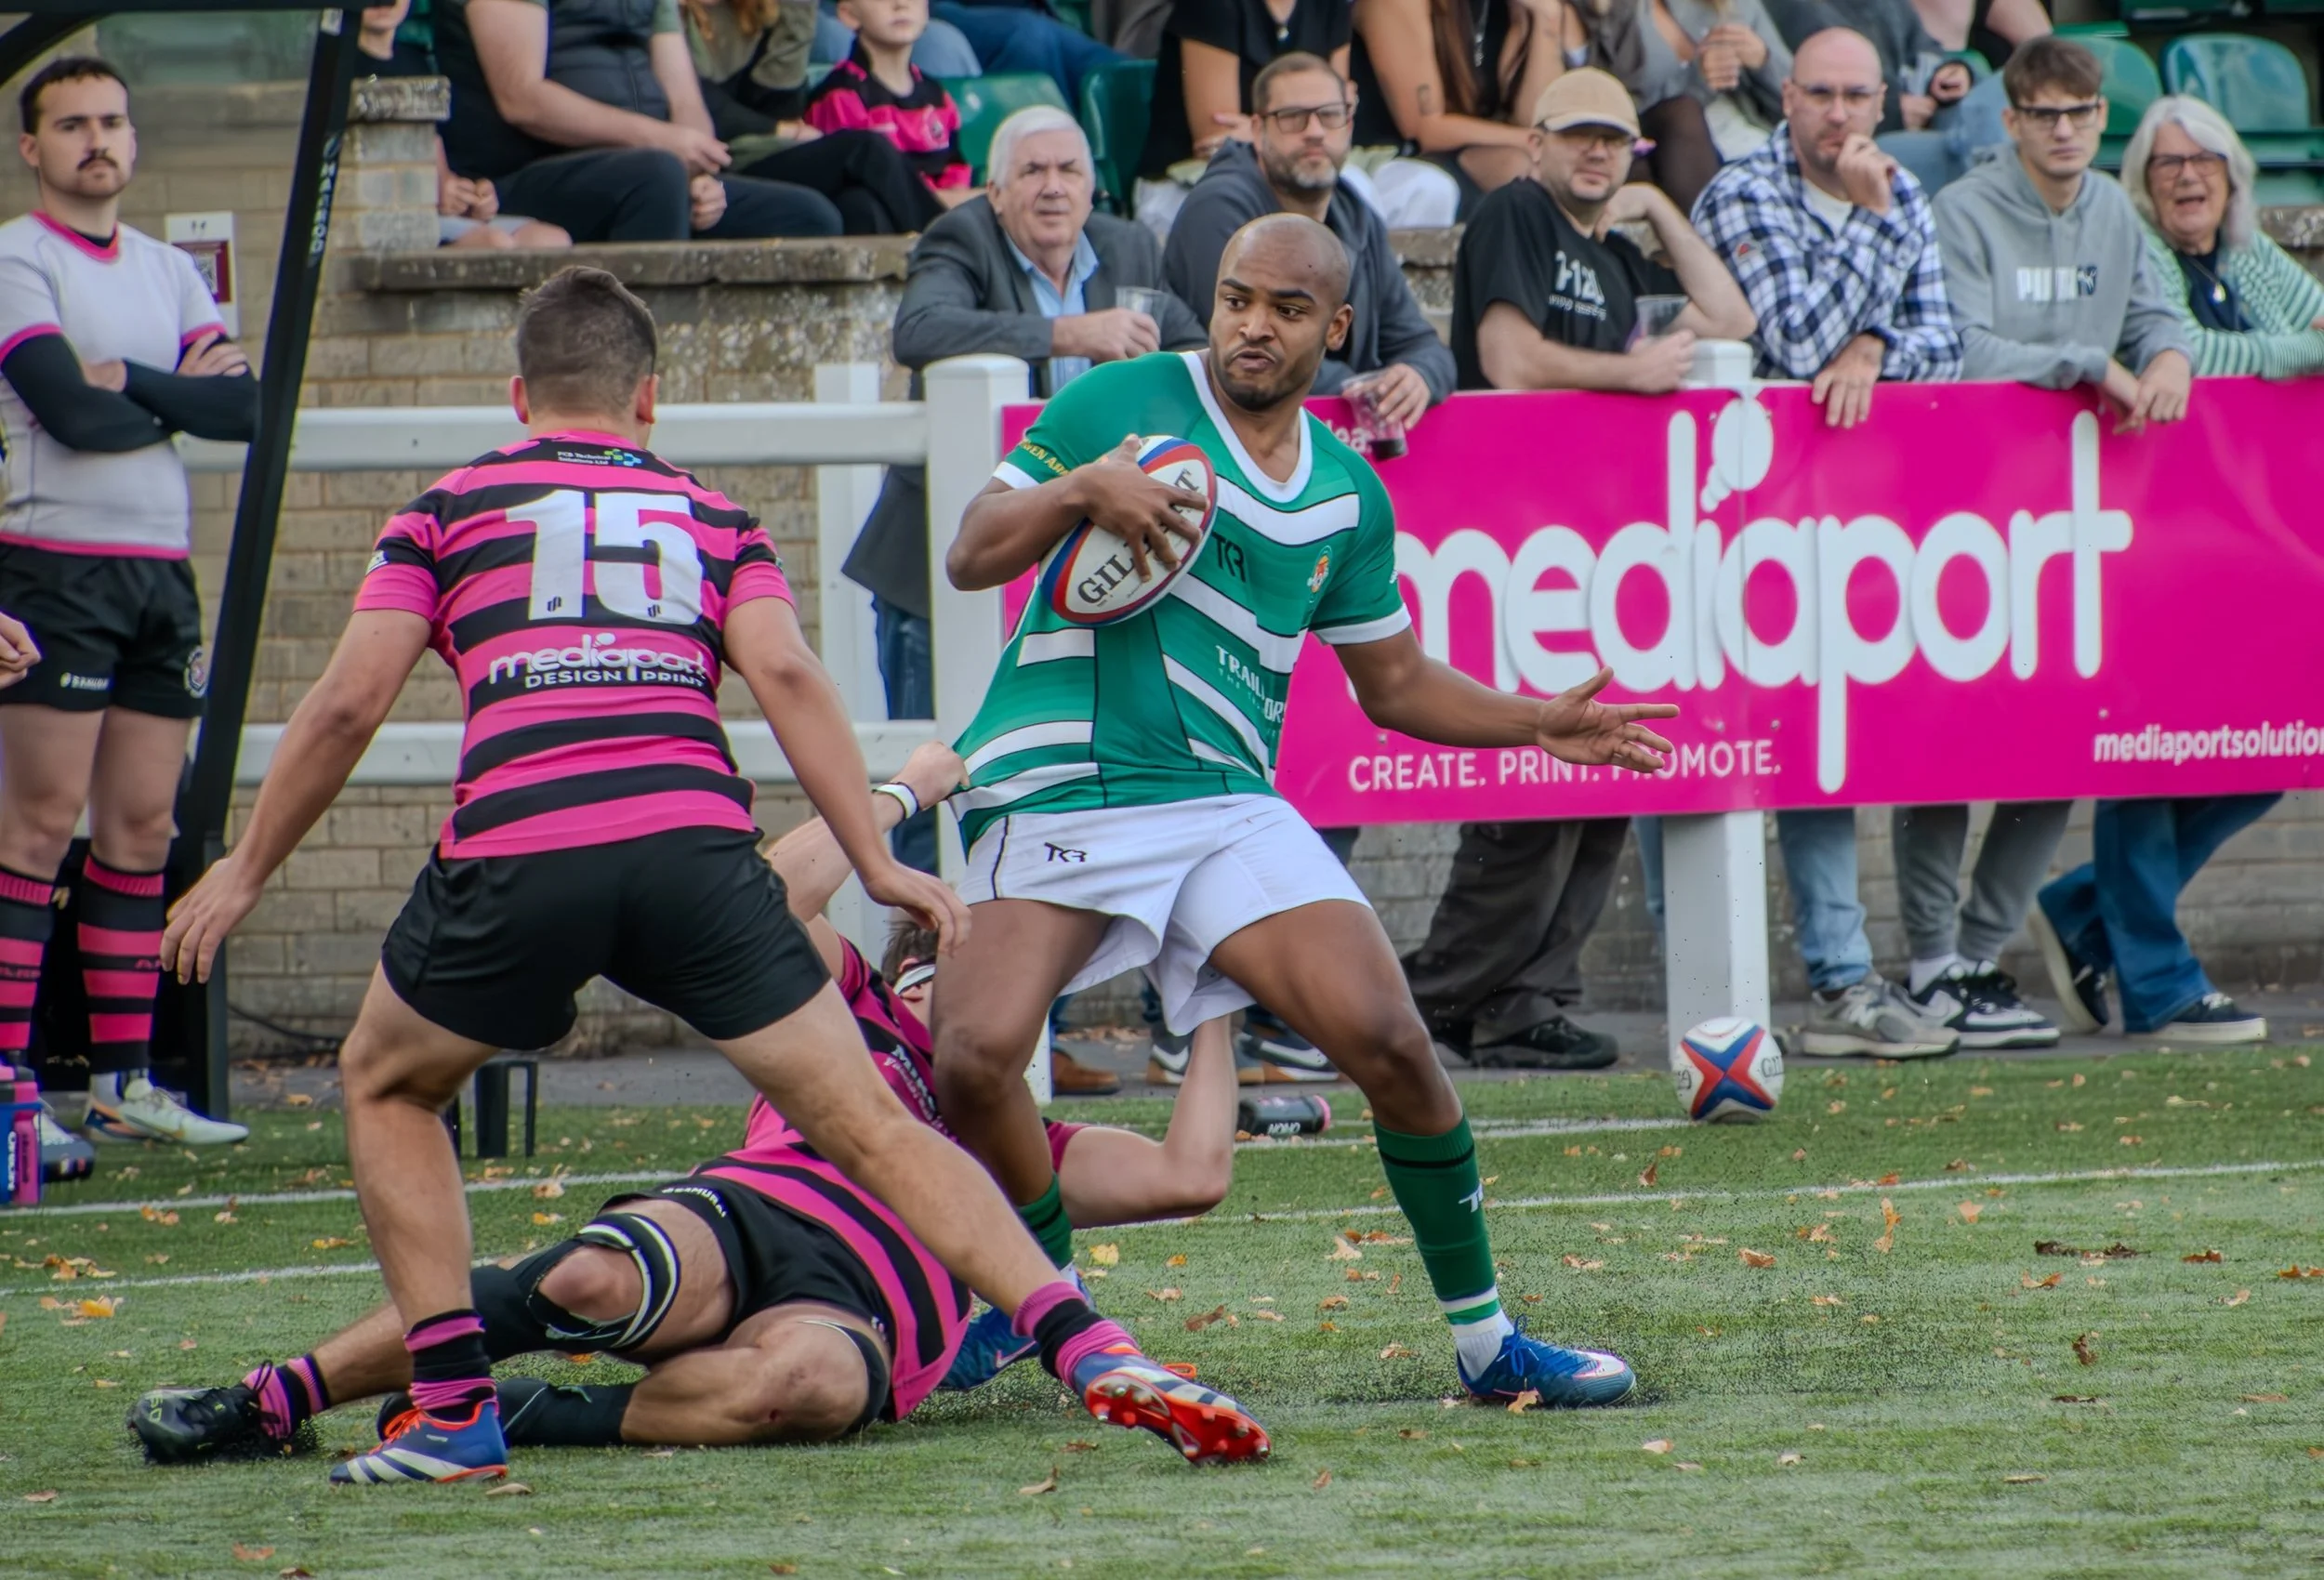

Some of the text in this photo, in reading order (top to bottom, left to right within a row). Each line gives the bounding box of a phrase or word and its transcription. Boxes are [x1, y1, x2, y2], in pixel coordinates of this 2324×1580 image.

[506, 489, 705, 625] 15
[1077, 467, 1200, 604] GILT
[1346, 398, 2133, 795] mediaport
[525, 669, 704, 690] DESIGN PRINT
[1348, 753, 1486, 792] CREATE.
[1611, 740, 1781, 782] OMOTE.
